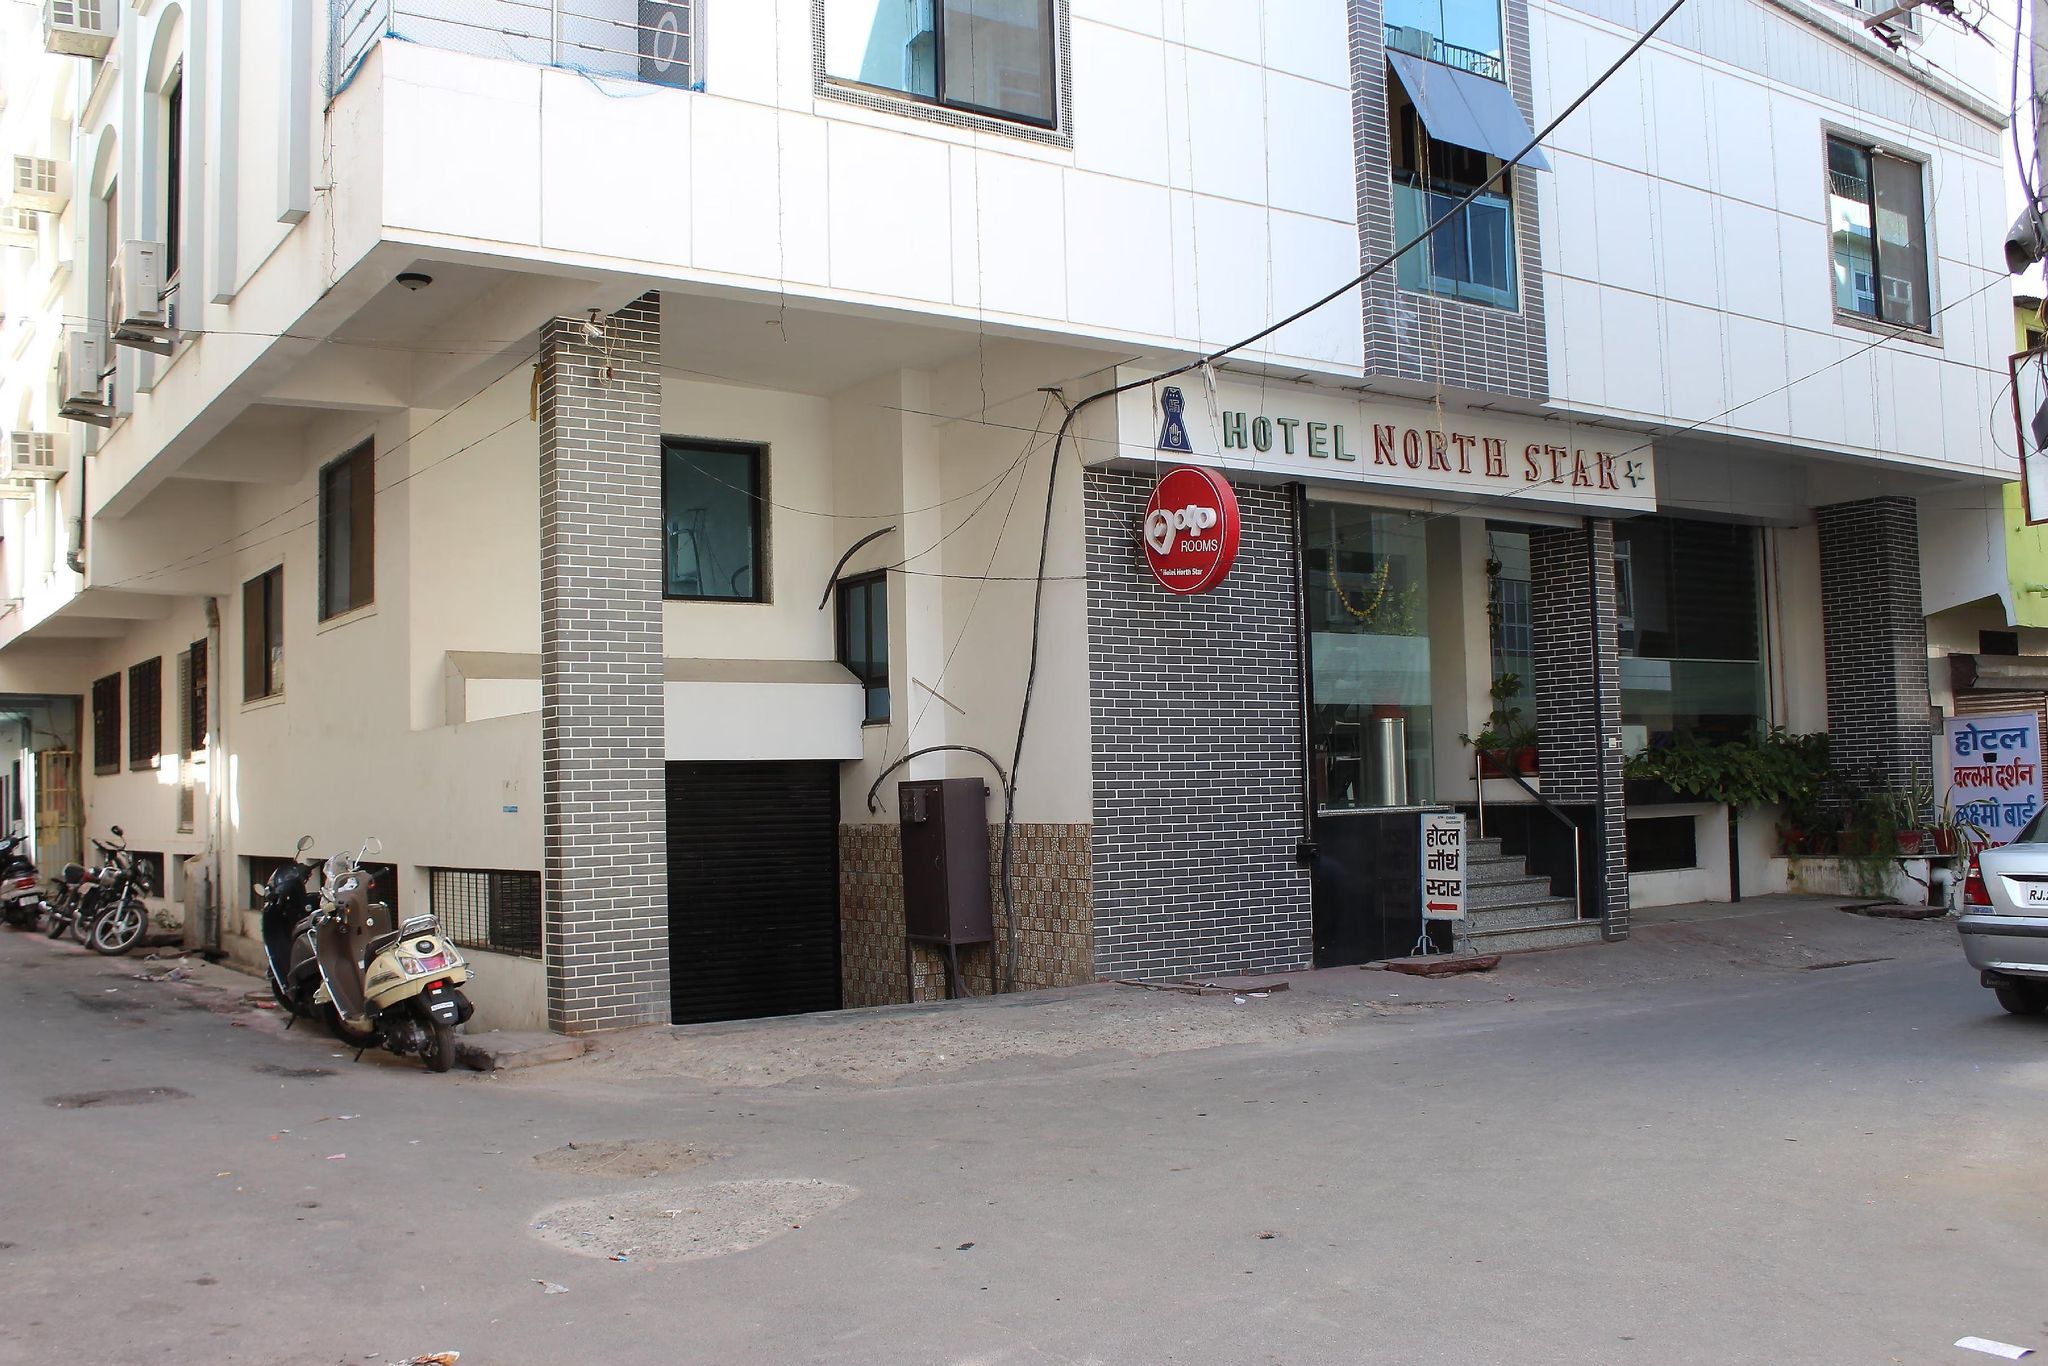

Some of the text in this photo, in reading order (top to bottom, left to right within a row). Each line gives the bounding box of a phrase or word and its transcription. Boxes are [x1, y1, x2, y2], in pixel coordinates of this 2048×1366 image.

[1223, 411, 1620, 490] HOTEL NORTH STAR
[1181, 539, 1218, 552] ROOMS
[1176, 568, 1191, 576] North
[1191, 567, 1203, 576] Star
[1954, 722, 2030, 756] होटल
[1953, 756, 2036, 791] वल्लभ दर्शन
[1426, 824, 1461, 848] होटल
[1425, 878, 1462, 897] स्टार
[2029, 889, 2048, 901] RJ.
